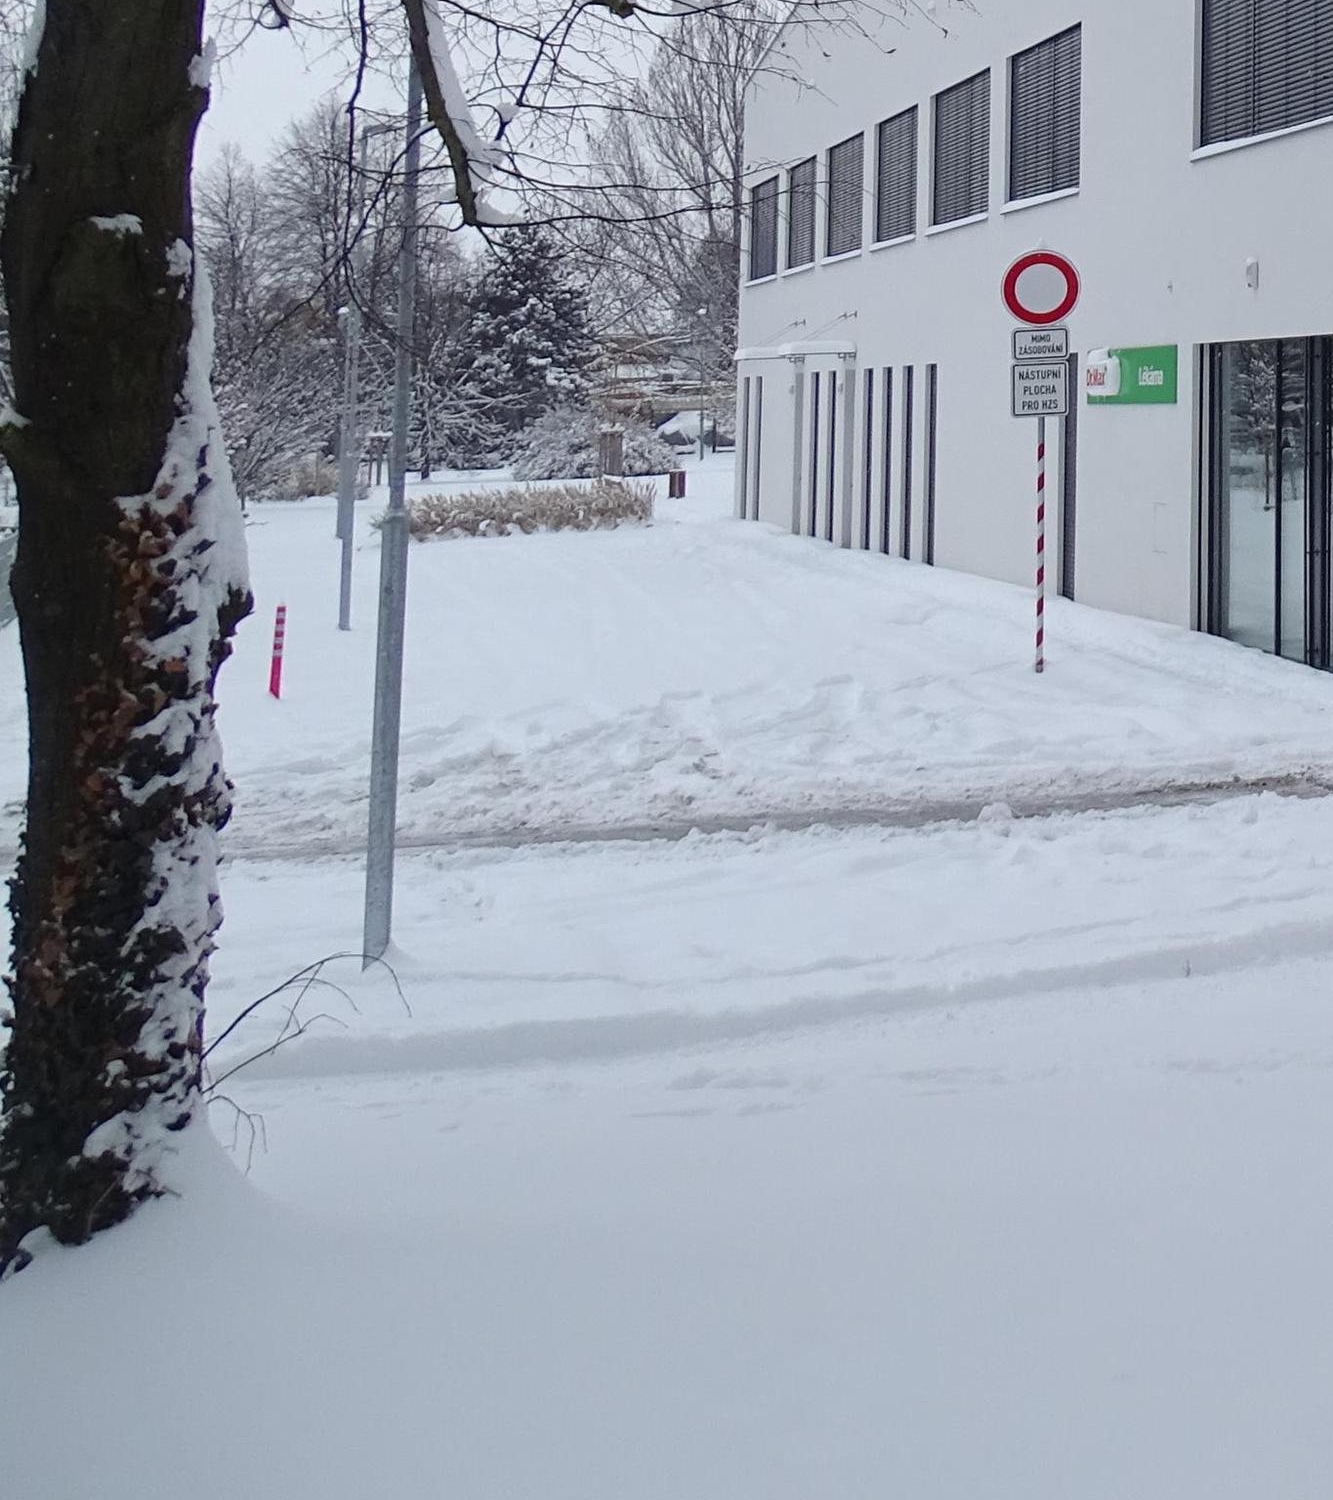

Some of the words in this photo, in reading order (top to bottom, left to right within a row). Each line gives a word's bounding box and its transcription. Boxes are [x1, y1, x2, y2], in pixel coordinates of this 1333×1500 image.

[1031, 334, 1051, 342] MIMO
[1019, 343, 1063, 355] ZÁSOBOVÁNÍ
[1019, 367, 1061, 380] NÁSTUPNÍ
[1023, 385, 1056, 395] PLOCHA
[1022, 401, 1039, 410] PRO
[1042, 400, 1058, 409] HZS
